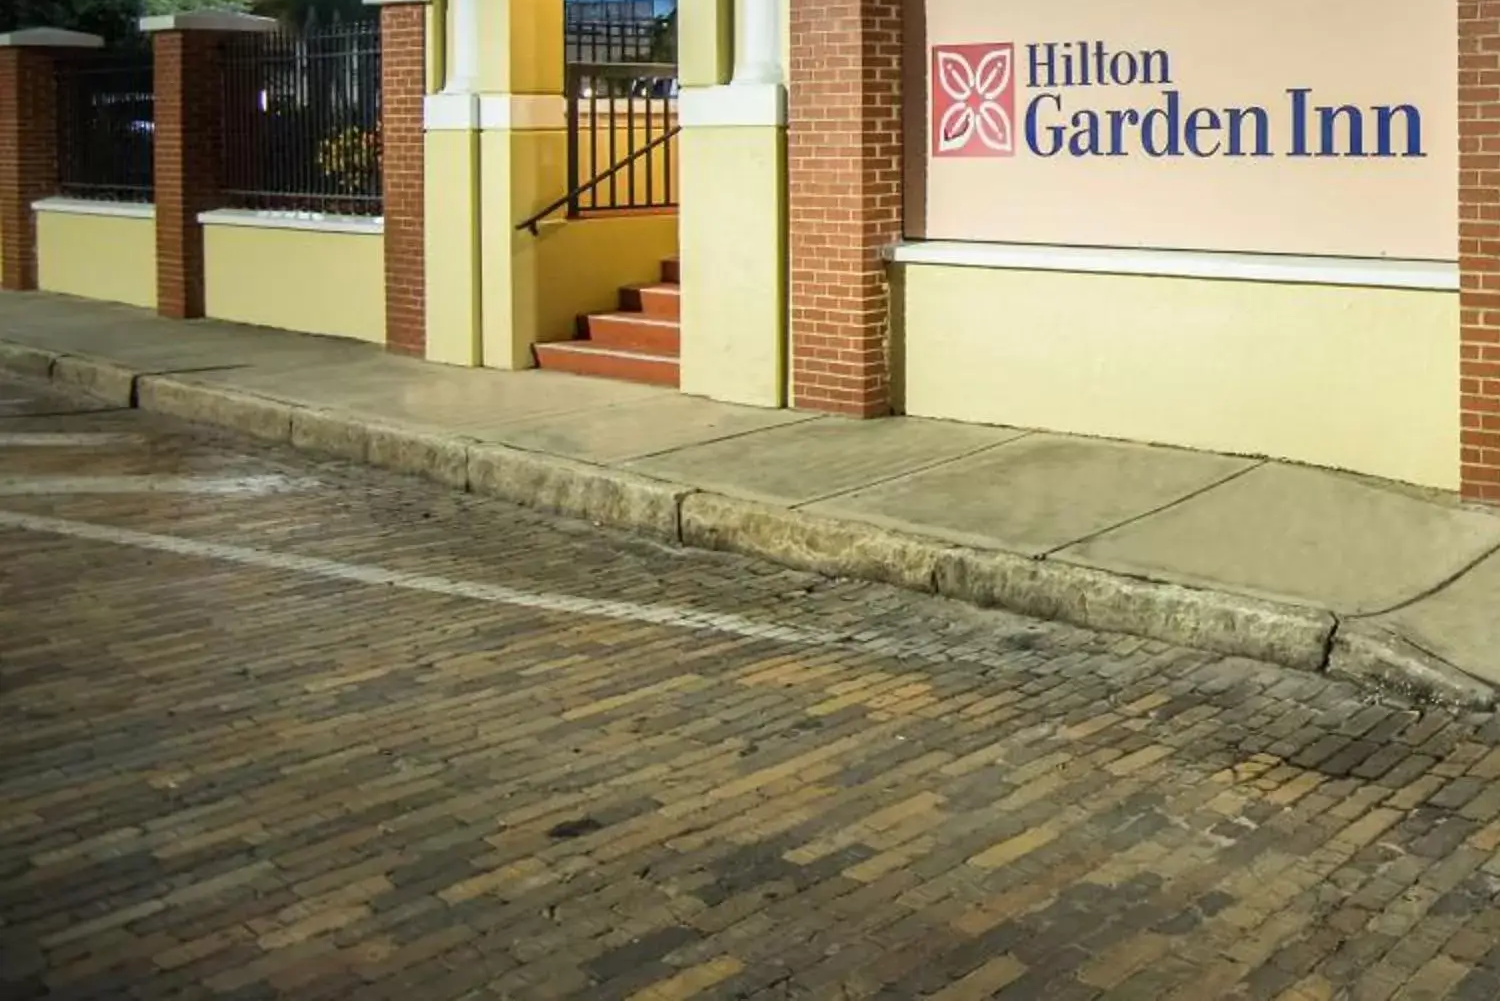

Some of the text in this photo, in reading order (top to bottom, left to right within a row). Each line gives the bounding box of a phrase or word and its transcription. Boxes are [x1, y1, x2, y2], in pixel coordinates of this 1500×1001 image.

[1025, 40, 1172, 87] Hilton
[1024, 87, 1428, 158] Garden Inn
